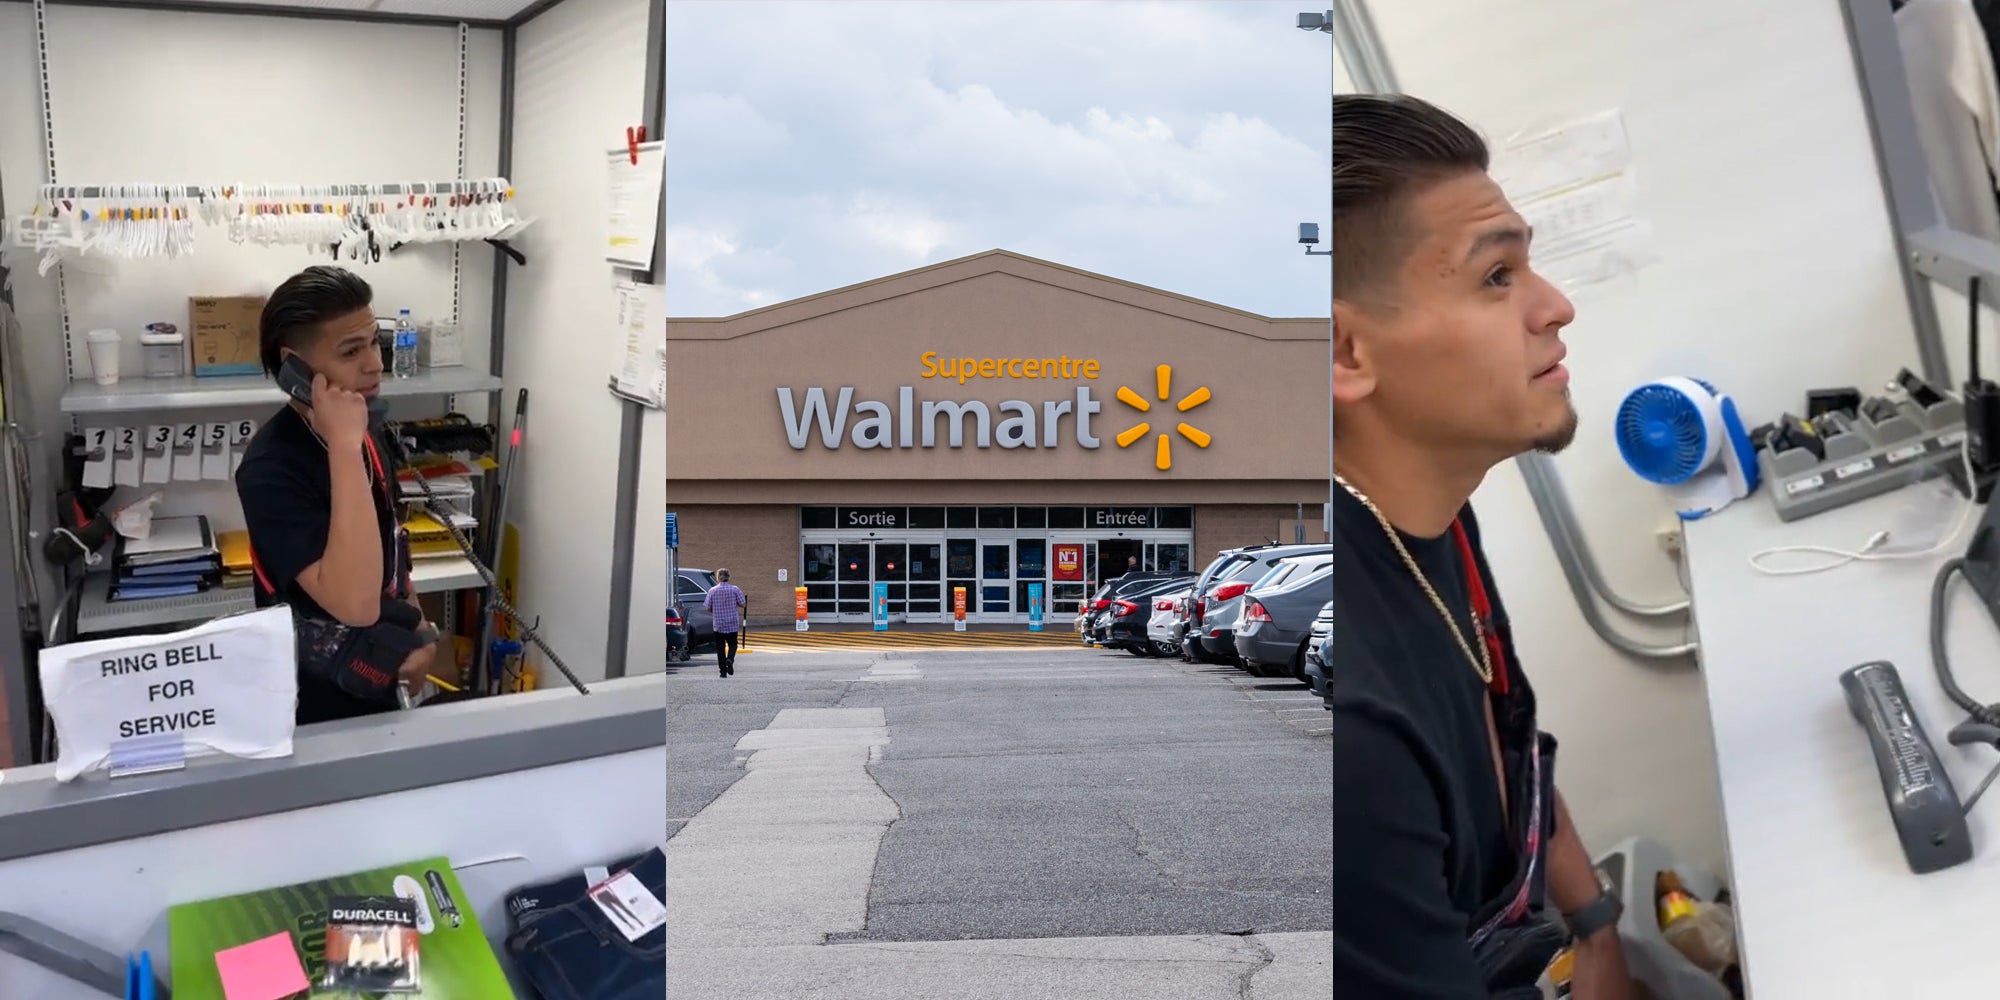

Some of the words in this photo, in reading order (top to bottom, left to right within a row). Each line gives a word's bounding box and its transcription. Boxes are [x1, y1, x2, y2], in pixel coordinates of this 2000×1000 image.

[921, 351, 1100, 384] Supercentre
[776, 385, 1100, 450] Walmart
[123, 429, 133, 444] 2
[155, 427, 170, 442] 3
[182, 425, 197, 439] 4
[211, 425, 225, 439] 5
[239, 422, 251, 436] 6
[94, 430, 106, 445] 1
[849, 511, 896, 526] Sortie
[1096, 511, 1146, 526] Entrée
[101, 653, 158, 677] RING
[165, 643, 223, 667] BELL
[148, 679, 194, 702] FOR
[119, 708, 216, 738] SERVICE
[332, 909, 412, 923] DURACELL
